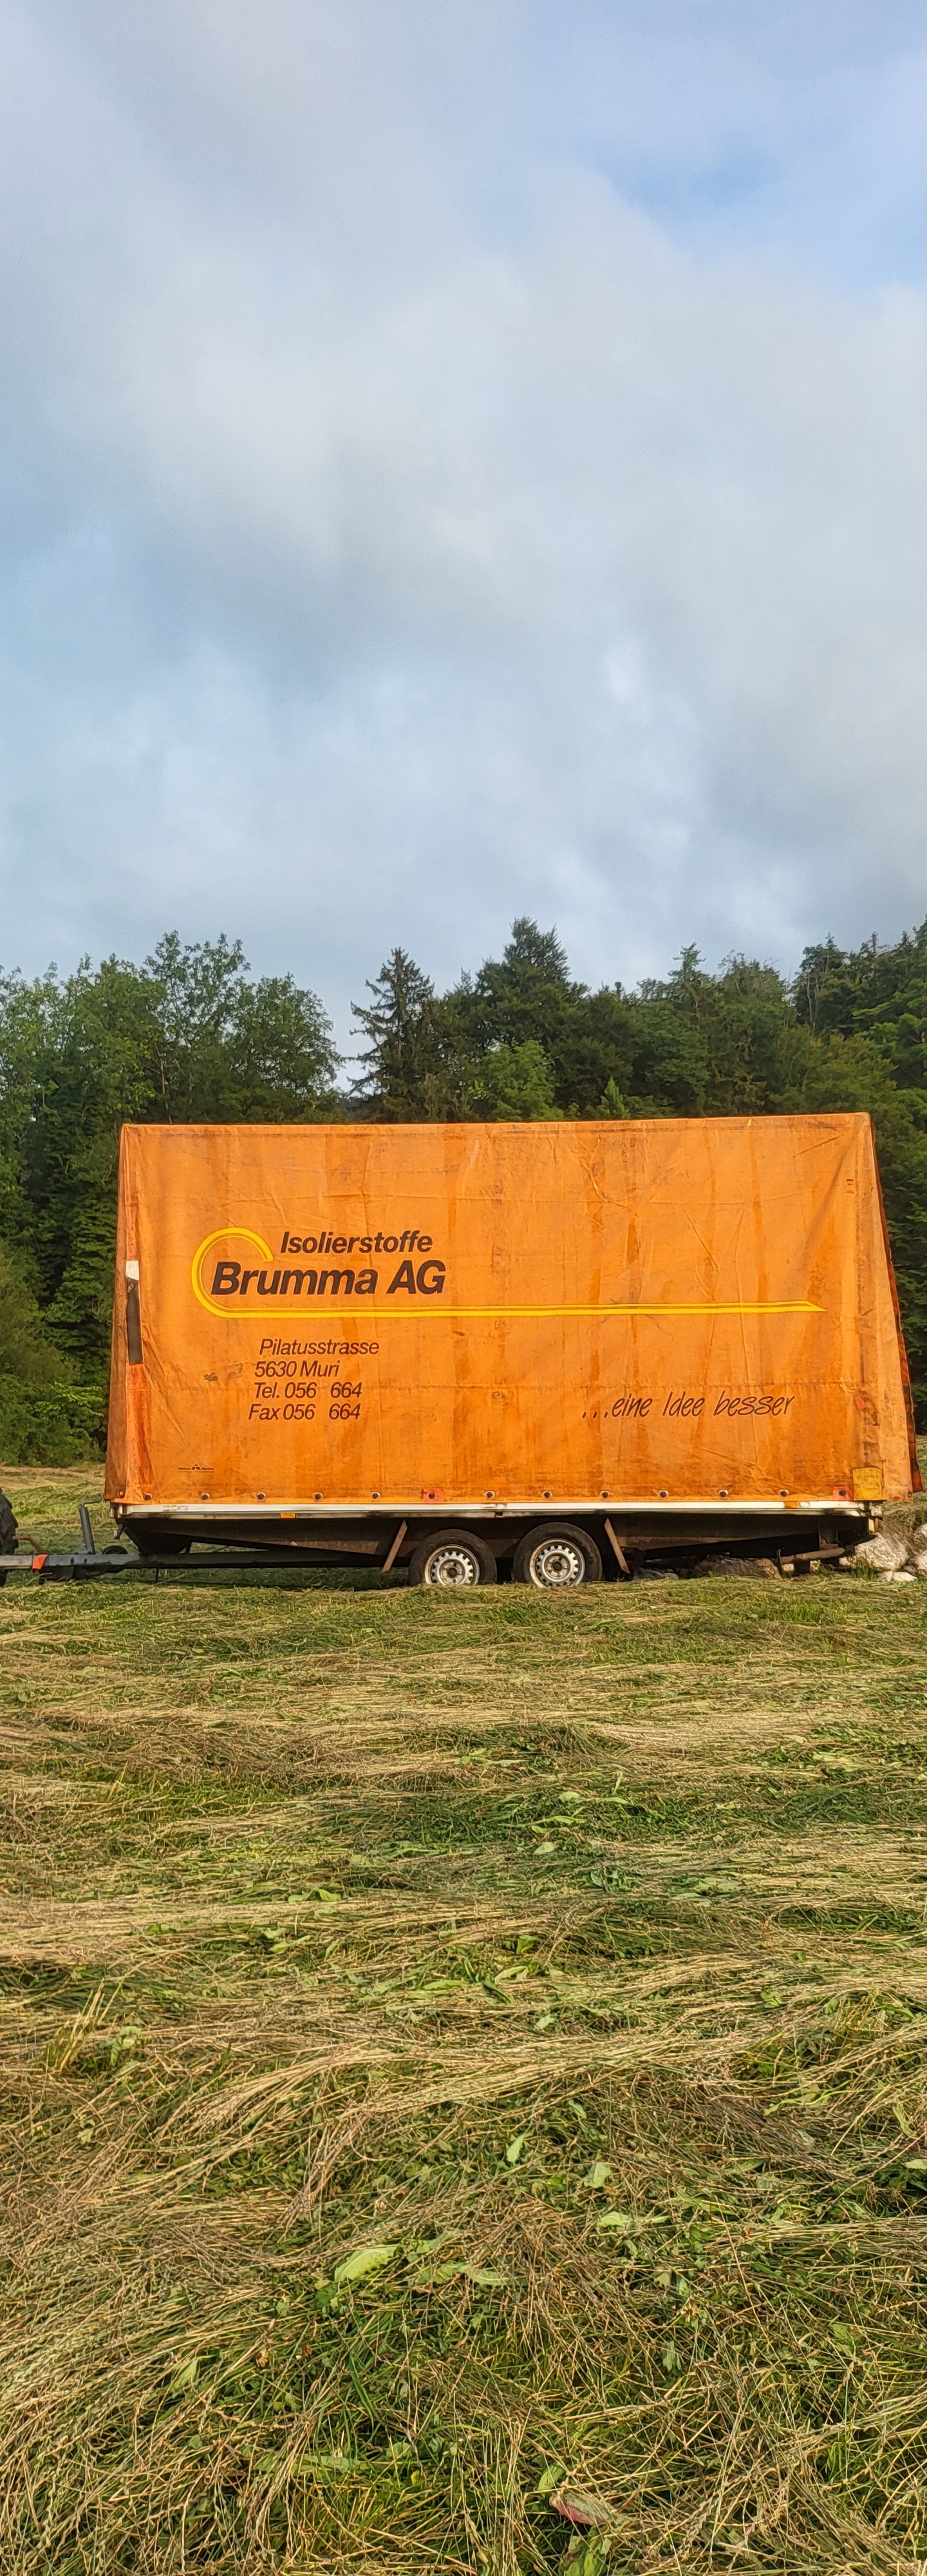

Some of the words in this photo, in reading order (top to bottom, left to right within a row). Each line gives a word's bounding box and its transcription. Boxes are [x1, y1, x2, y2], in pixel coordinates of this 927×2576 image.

[279, 1230, 433, 1254] Isolierstoffe
[211, 1261, 379, 1296] Brumma
[385, 1259, 447, 1294] AG
[259, 1338, 380, 1356] Pilatusstrasse
[254, 1360, 297, 1378] 5630
[299, 1359, 341, 1378] Muri
[254, 1381, 281, 1399] Tel.
[284, 1381, 317, 1399] 056
[330, 1381, 363, 1398] 664
[248, 1403, 281, 1421] Fax
[283, 1403, 316, 1420] 056
[328, 1402, 361, 1420] 664
[662, 1390, 706, 1417] Idee
[713, 1390, 796, 1417] besser
